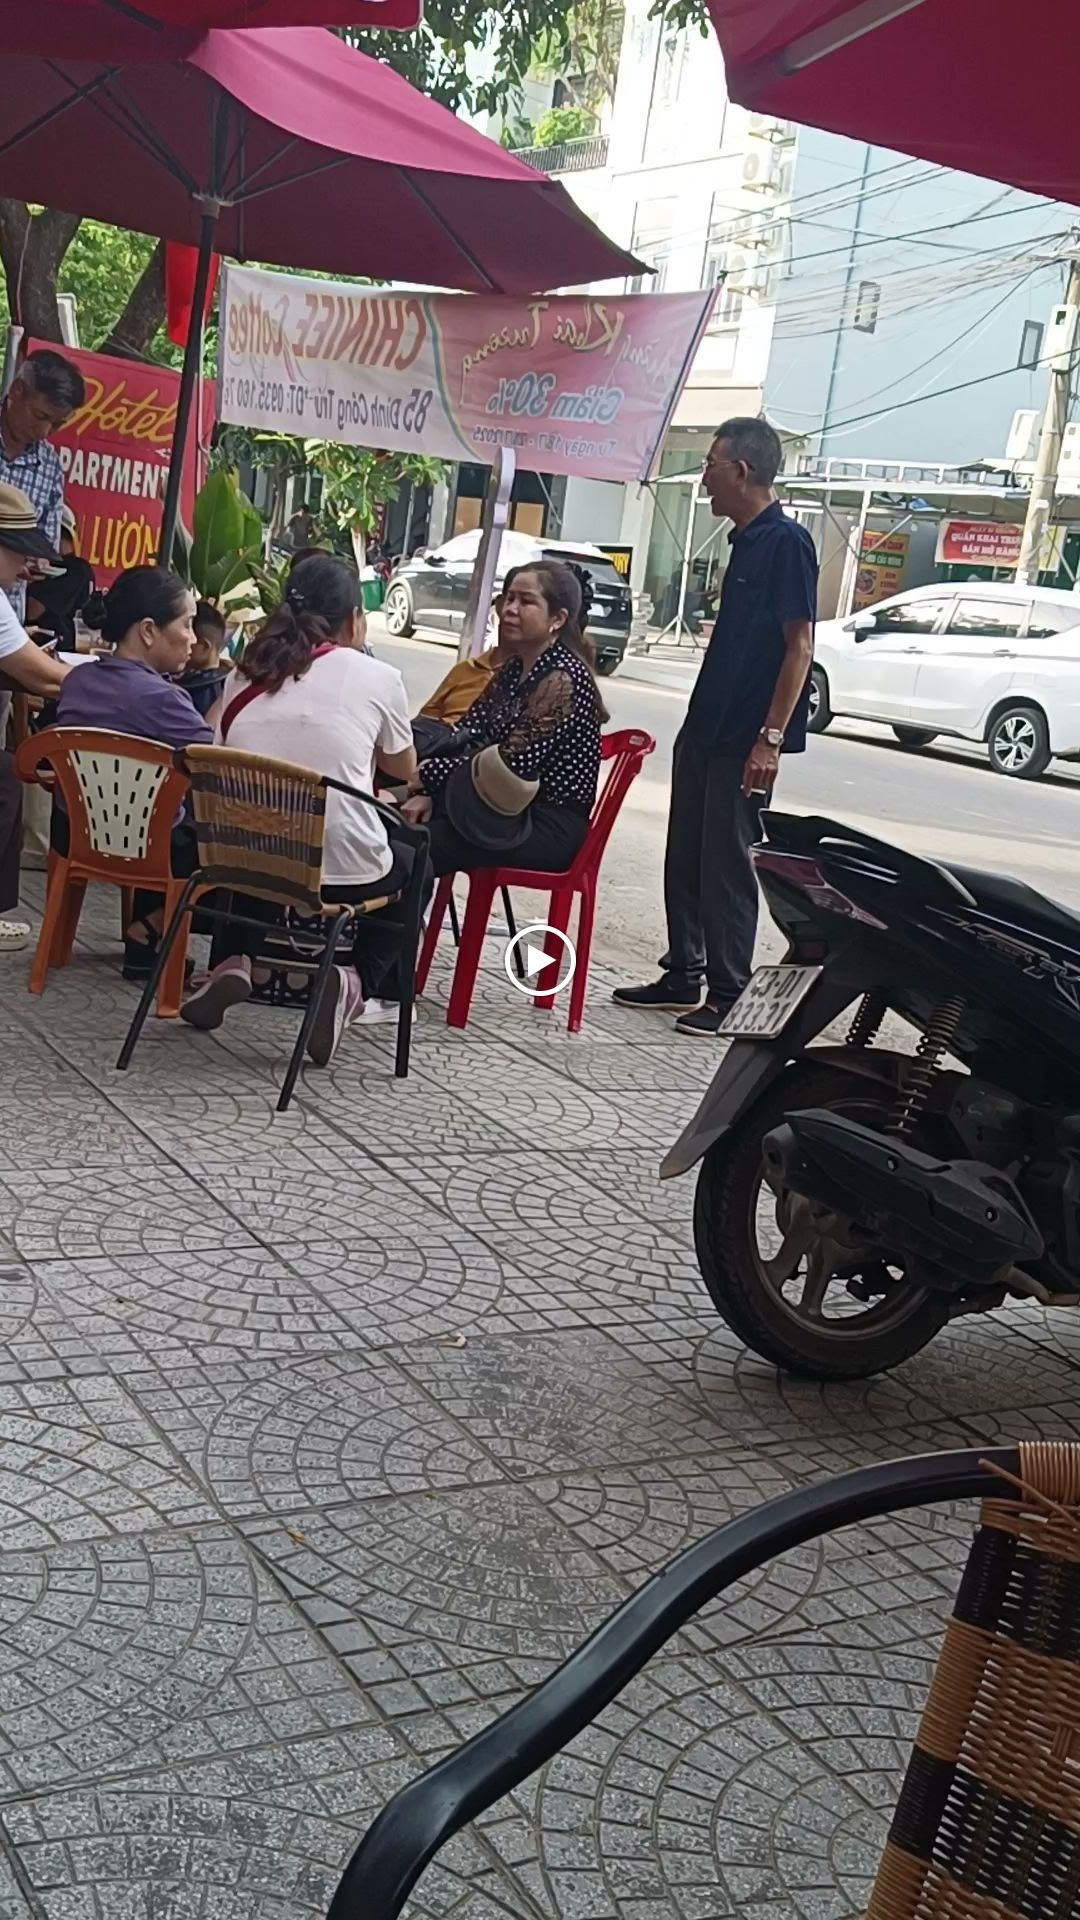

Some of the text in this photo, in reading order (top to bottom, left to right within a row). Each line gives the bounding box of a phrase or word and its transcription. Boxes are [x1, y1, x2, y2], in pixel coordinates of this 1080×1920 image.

[57, 376, 178, 443] Hotel
[977, 533, 999, 543] KHAI
[722, 1002, 791, 1032] 833.31
